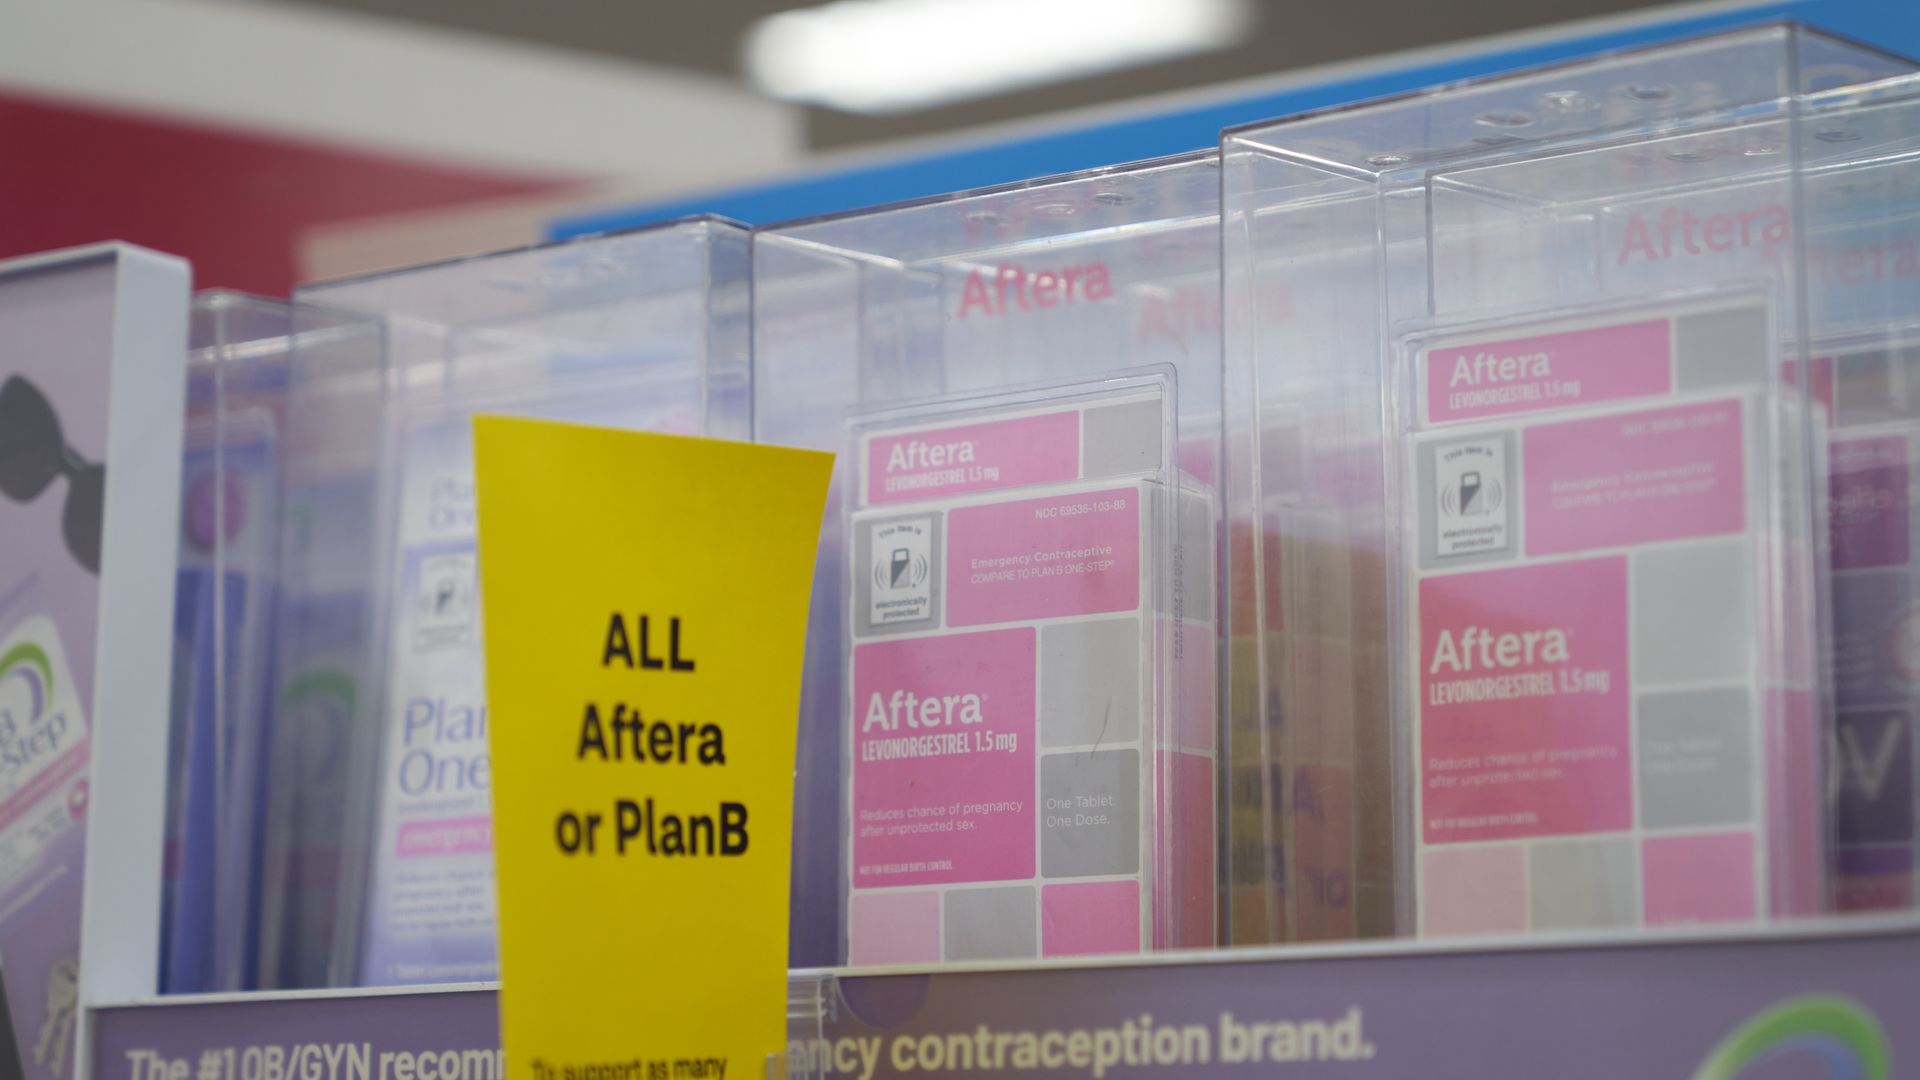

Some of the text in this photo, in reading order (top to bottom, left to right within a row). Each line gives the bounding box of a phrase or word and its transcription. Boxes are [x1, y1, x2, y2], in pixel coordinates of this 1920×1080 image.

[957, 261, 1114, 319] Aftera
[1450, 351, 1551, 387] Aftera
[1563, 380, 1580, 398] mg
[887, 438, 975, 472] Aftera
[886, 465, 1000, 493] LEVONORGESTREL 1.5 mg
[1035, 506, 1057, 519] NDC
[972, 546, 1112, 569] Emergency Contraceptive
[970, 569, 1016, 584] COMPARE
[1018, 568, 1030, 580] TO
[1031, 566, 1055, 578] PLAN
[875, 596, 928, 610] electronically
[882, 607, 921, 620] protected
[602, 613, 695, 672] ALL
[1430, 625, 1570, 674] Aftera
[1429, 668, 1611, 706] LEVONORGESTREL 1.5 mg
[862, 690, 983, 732] Aftera
[577, 703, 726, 766] Aftera
[862, 730, 1018, 762] LEVONORGESTREL 1.5 mg
[859, 799, 1024, 823] Reduces chance of pregnancy
[1046, 794, 1117, 811] One Tablet.
[556, 797, 750, 857] or PlanB
[859, 819, 978, 838] after unprotected sex.
[1046, 813, 1111, 829] One Dose.
[126, 1048, 190, 1080] The
[890, 1012, 1211, 1078] contraception
[1220, 1006, 1376, 1064] brand.
[673, 1056, 728, 1080] many
